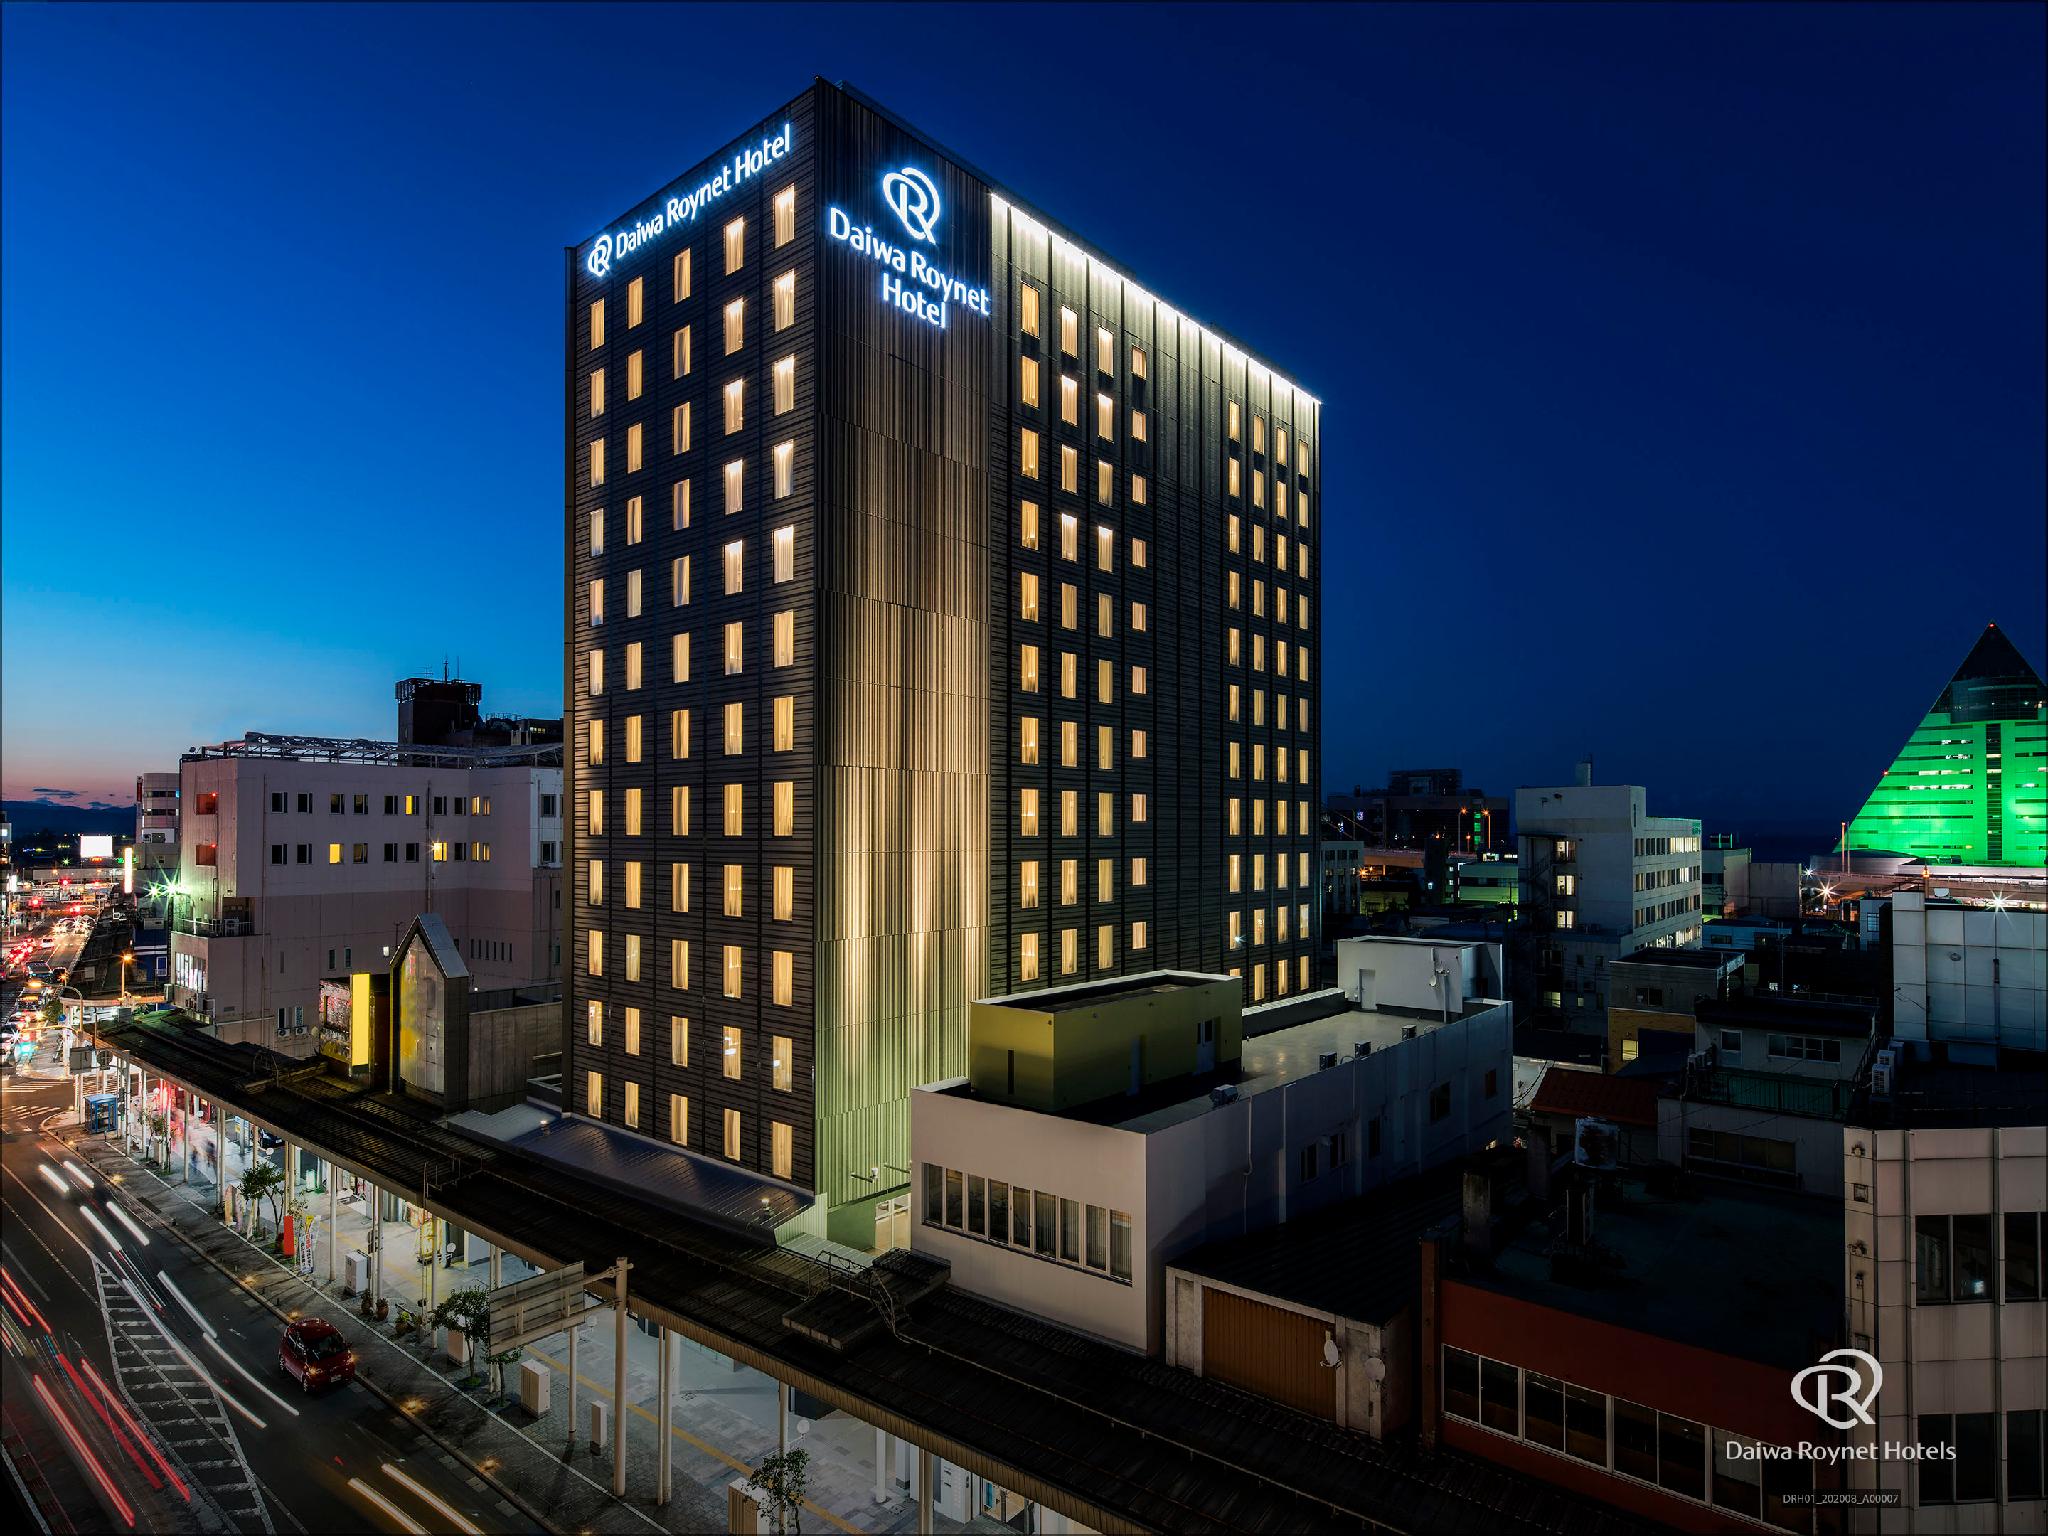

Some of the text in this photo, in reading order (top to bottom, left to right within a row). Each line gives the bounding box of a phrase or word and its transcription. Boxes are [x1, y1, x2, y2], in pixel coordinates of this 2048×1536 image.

[616, 215, 663, 259] Daiwa
[667, 165, 731, 223] Roynet
[735, 124, 790, 184] Hotel
[830, 207, 989, 316] Daiwa Roynet
[883, 273, 946, 328] Hotel
